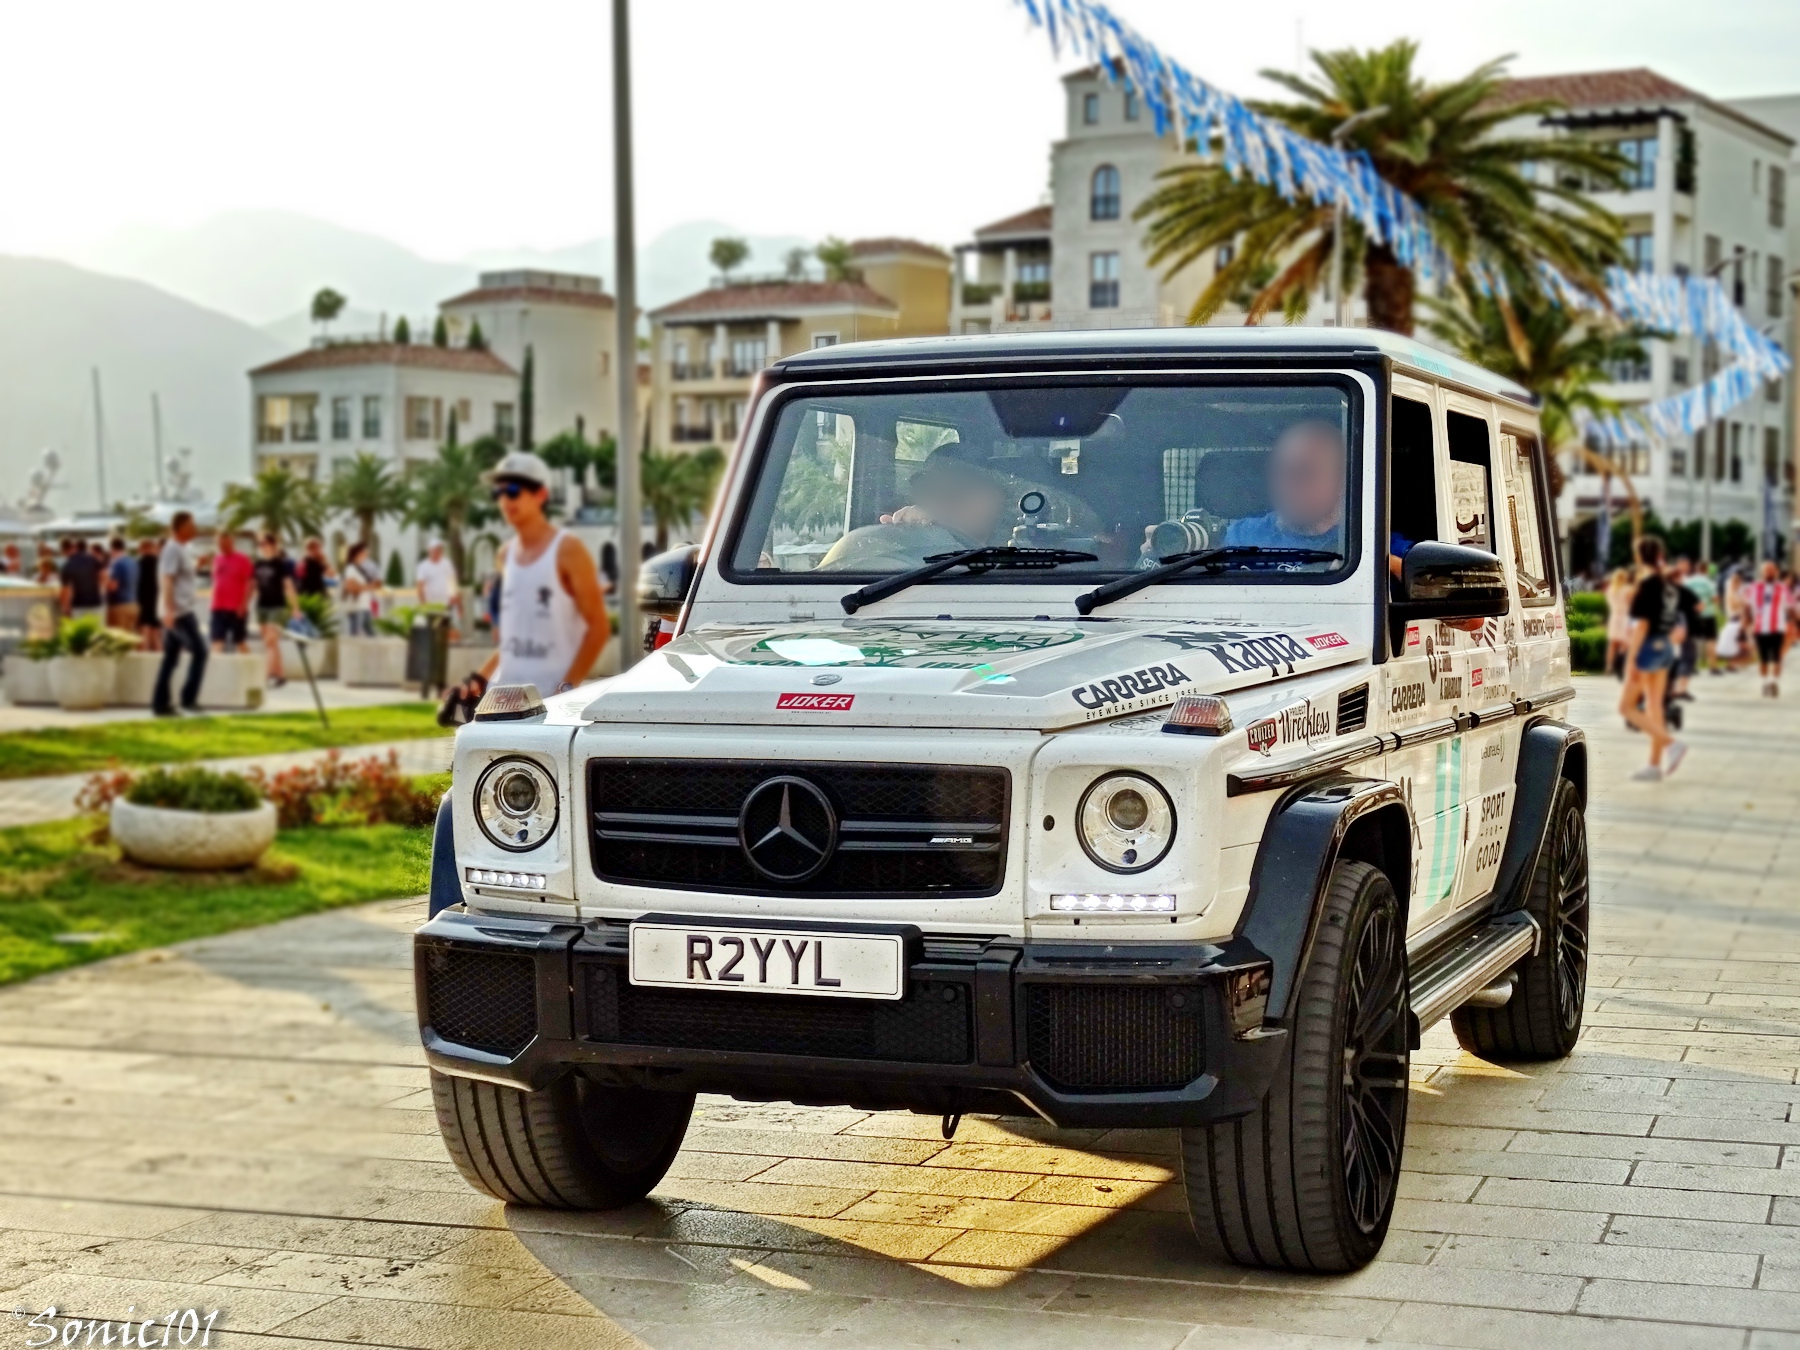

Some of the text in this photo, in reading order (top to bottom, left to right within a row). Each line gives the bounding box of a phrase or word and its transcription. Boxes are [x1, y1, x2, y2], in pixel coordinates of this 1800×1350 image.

[1208, 633, 1314, 677] Kappa
[1312, 634, 1346, 649] JOKER
[778, 696, 852, 708] JOKER
[1072, 662, 1192, 710] CARRERA
[1391, 682, 1426, 713] CARRERA
[1086, 702, 1134, 720] EYEWEAR
[1140, 694, 1170, 707] SINCE
[1279, 698, 1330, 748] Wreckless
[1249, 723, 1276, 744] CRUIZER
[1482, 791, 1506, 823] SPORT
[1476, 840, 1501, 873] GOOD
[686, 934, 842, 988] R2YYL
